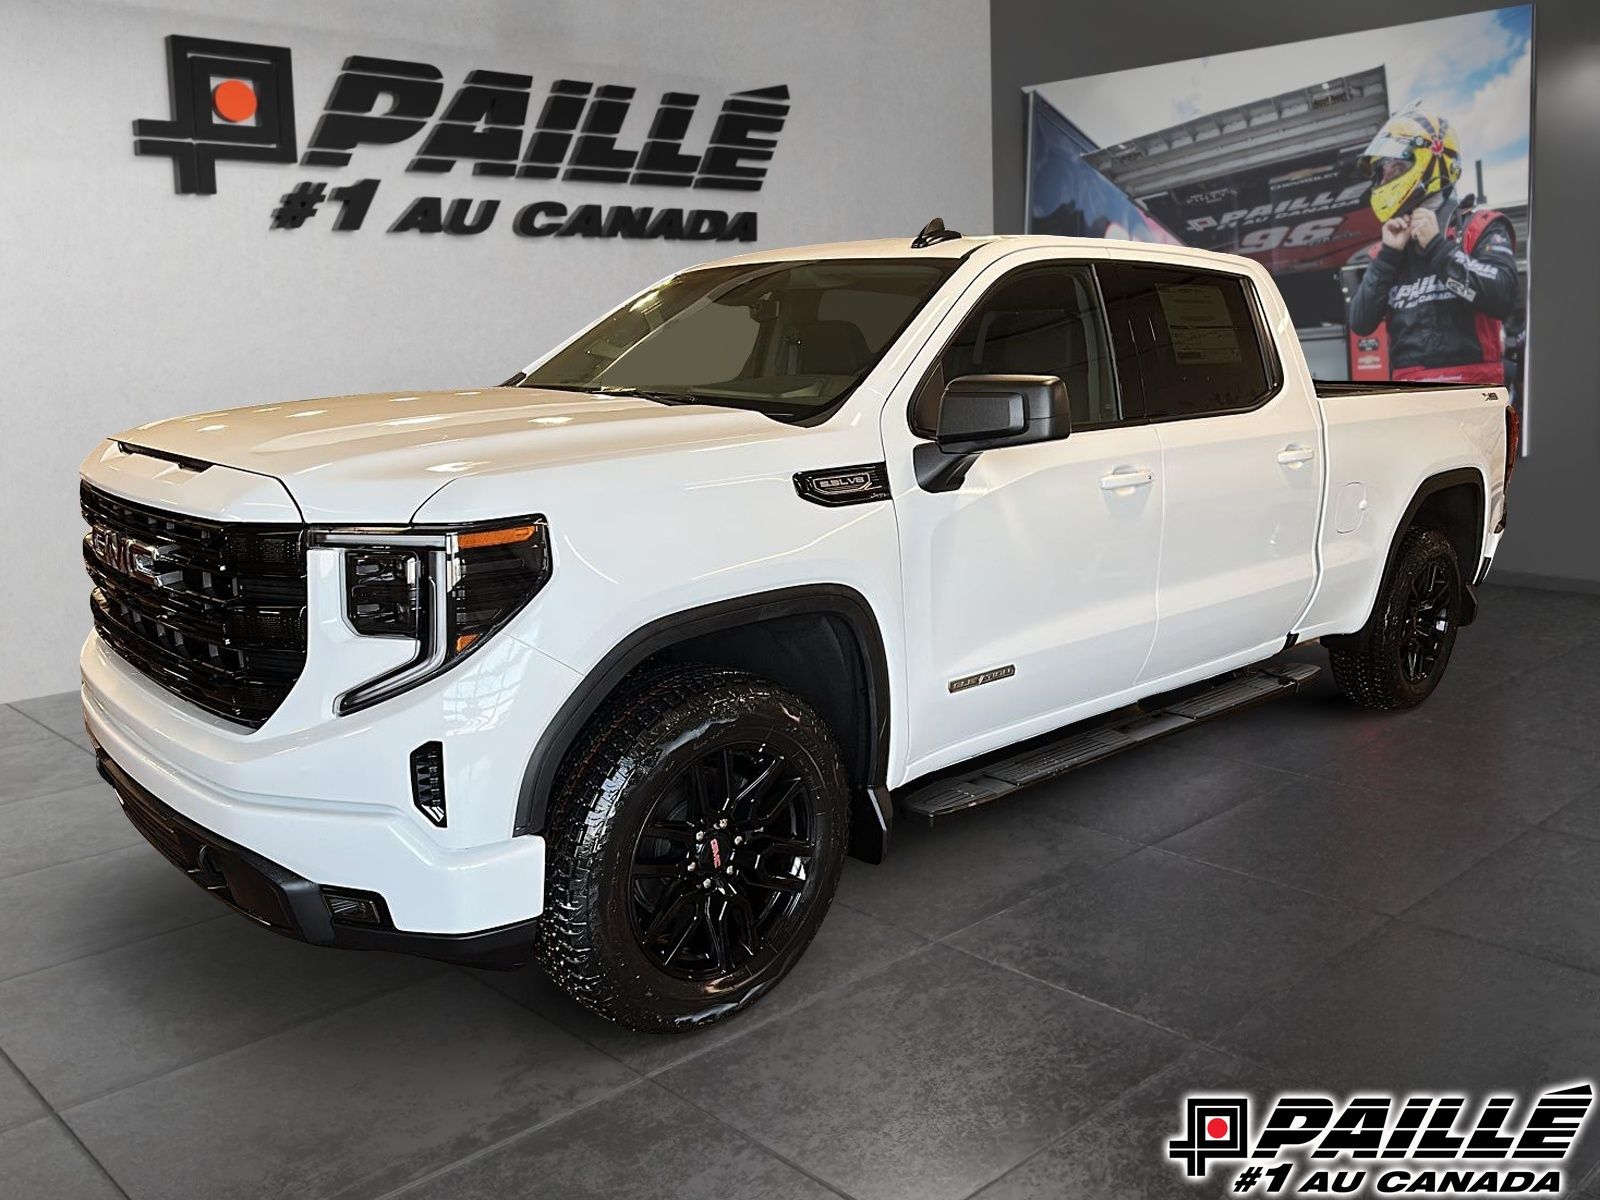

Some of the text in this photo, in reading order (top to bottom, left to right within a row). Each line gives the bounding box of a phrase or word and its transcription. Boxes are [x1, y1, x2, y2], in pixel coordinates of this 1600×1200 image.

[300, 55, 790, 191] PAILLÉ
[270, 179, 758, 242] #1 AU CANADA
[1238, 216, 1344, 254] 96
